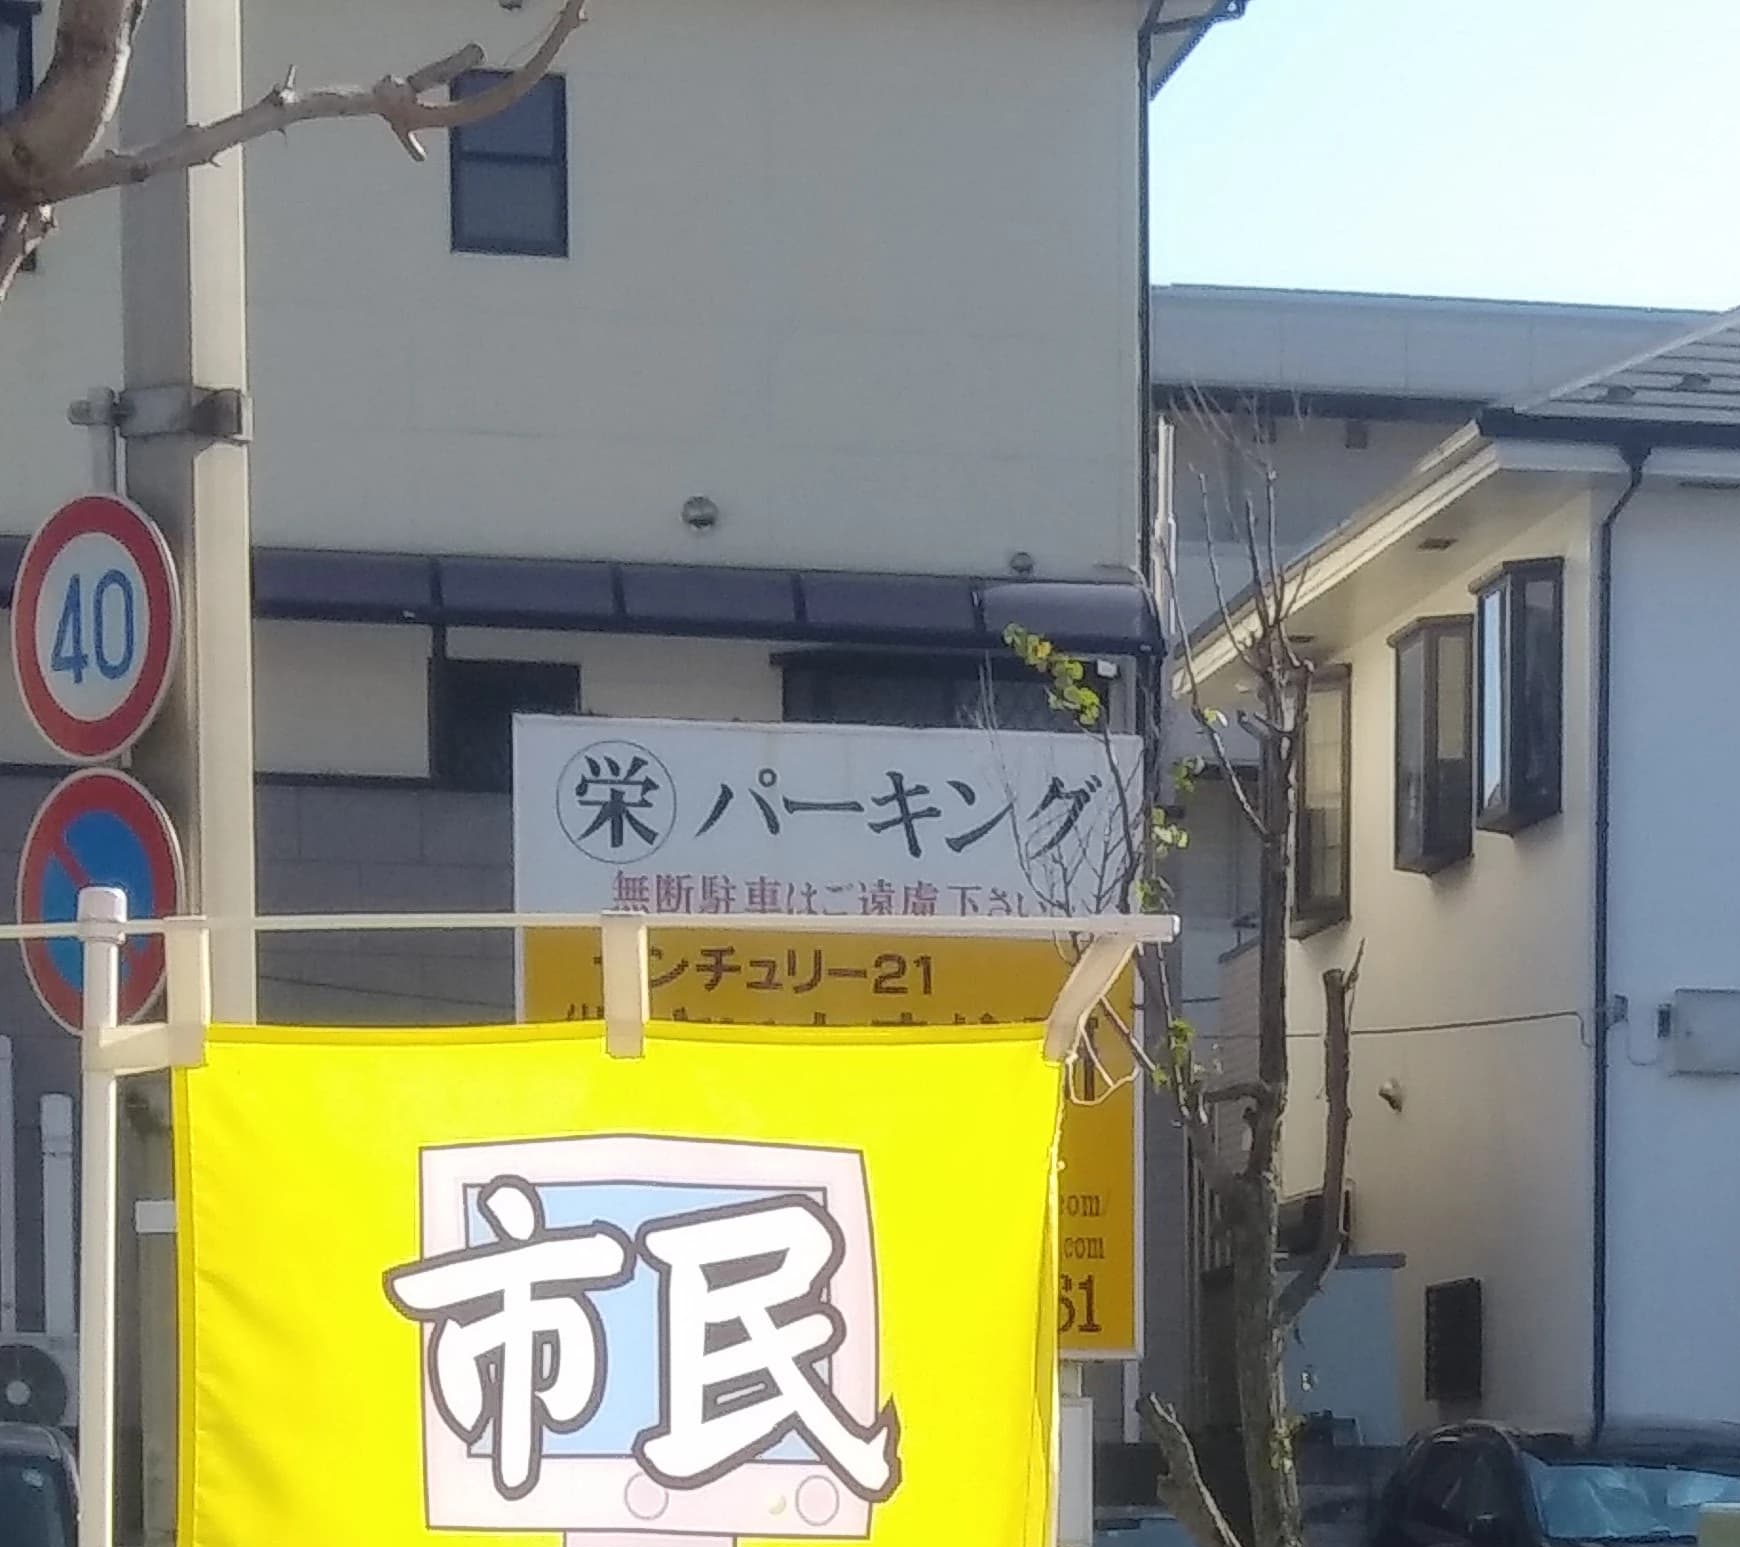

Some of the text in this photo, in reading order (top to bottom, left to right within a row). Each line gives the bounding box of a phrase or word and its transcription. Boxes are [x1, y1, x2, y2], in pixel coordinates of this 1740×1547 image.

[51, 568, 135, 684] 40
[574, 753, 1104, 858] 栄 パーキング
[592, 945, 932, 996] ンチュリー21
[382, 1176, 902, 1503] 市民
